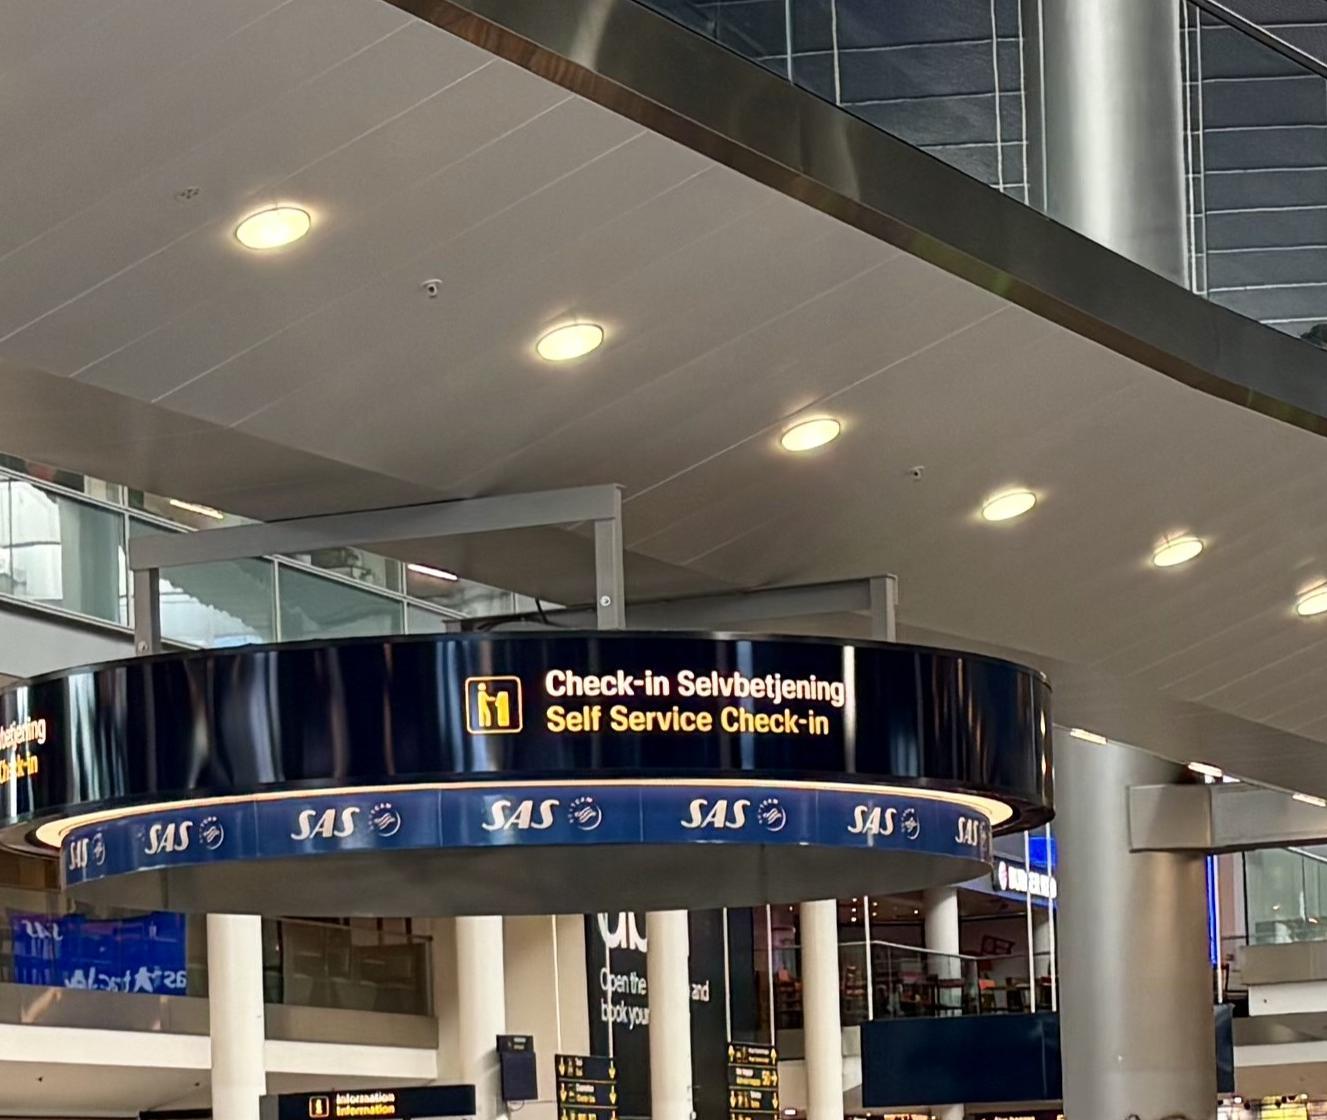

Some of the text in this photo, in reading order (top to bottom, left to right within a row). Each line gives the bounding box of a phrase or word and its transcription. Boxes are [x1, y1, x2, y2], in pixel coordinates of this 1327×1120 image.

[545, 668, 845, 707] Check-in Selvbetjening
[546, 704, 829, 736] Self Service Check-in
[289, 806, 360, 840] SAS
[481, 798, 560, 830] SAS
[680, 798, 750, 829] SAS
[847, 804, 897, 836] SAS
[143, 820, 193, 855] SAS
[629, 971, 647, 995] the
[691, 980, 710, 1002] and
[336, 1092, 396, 1105] Information
[336, 1103, 396, 1117] Information
